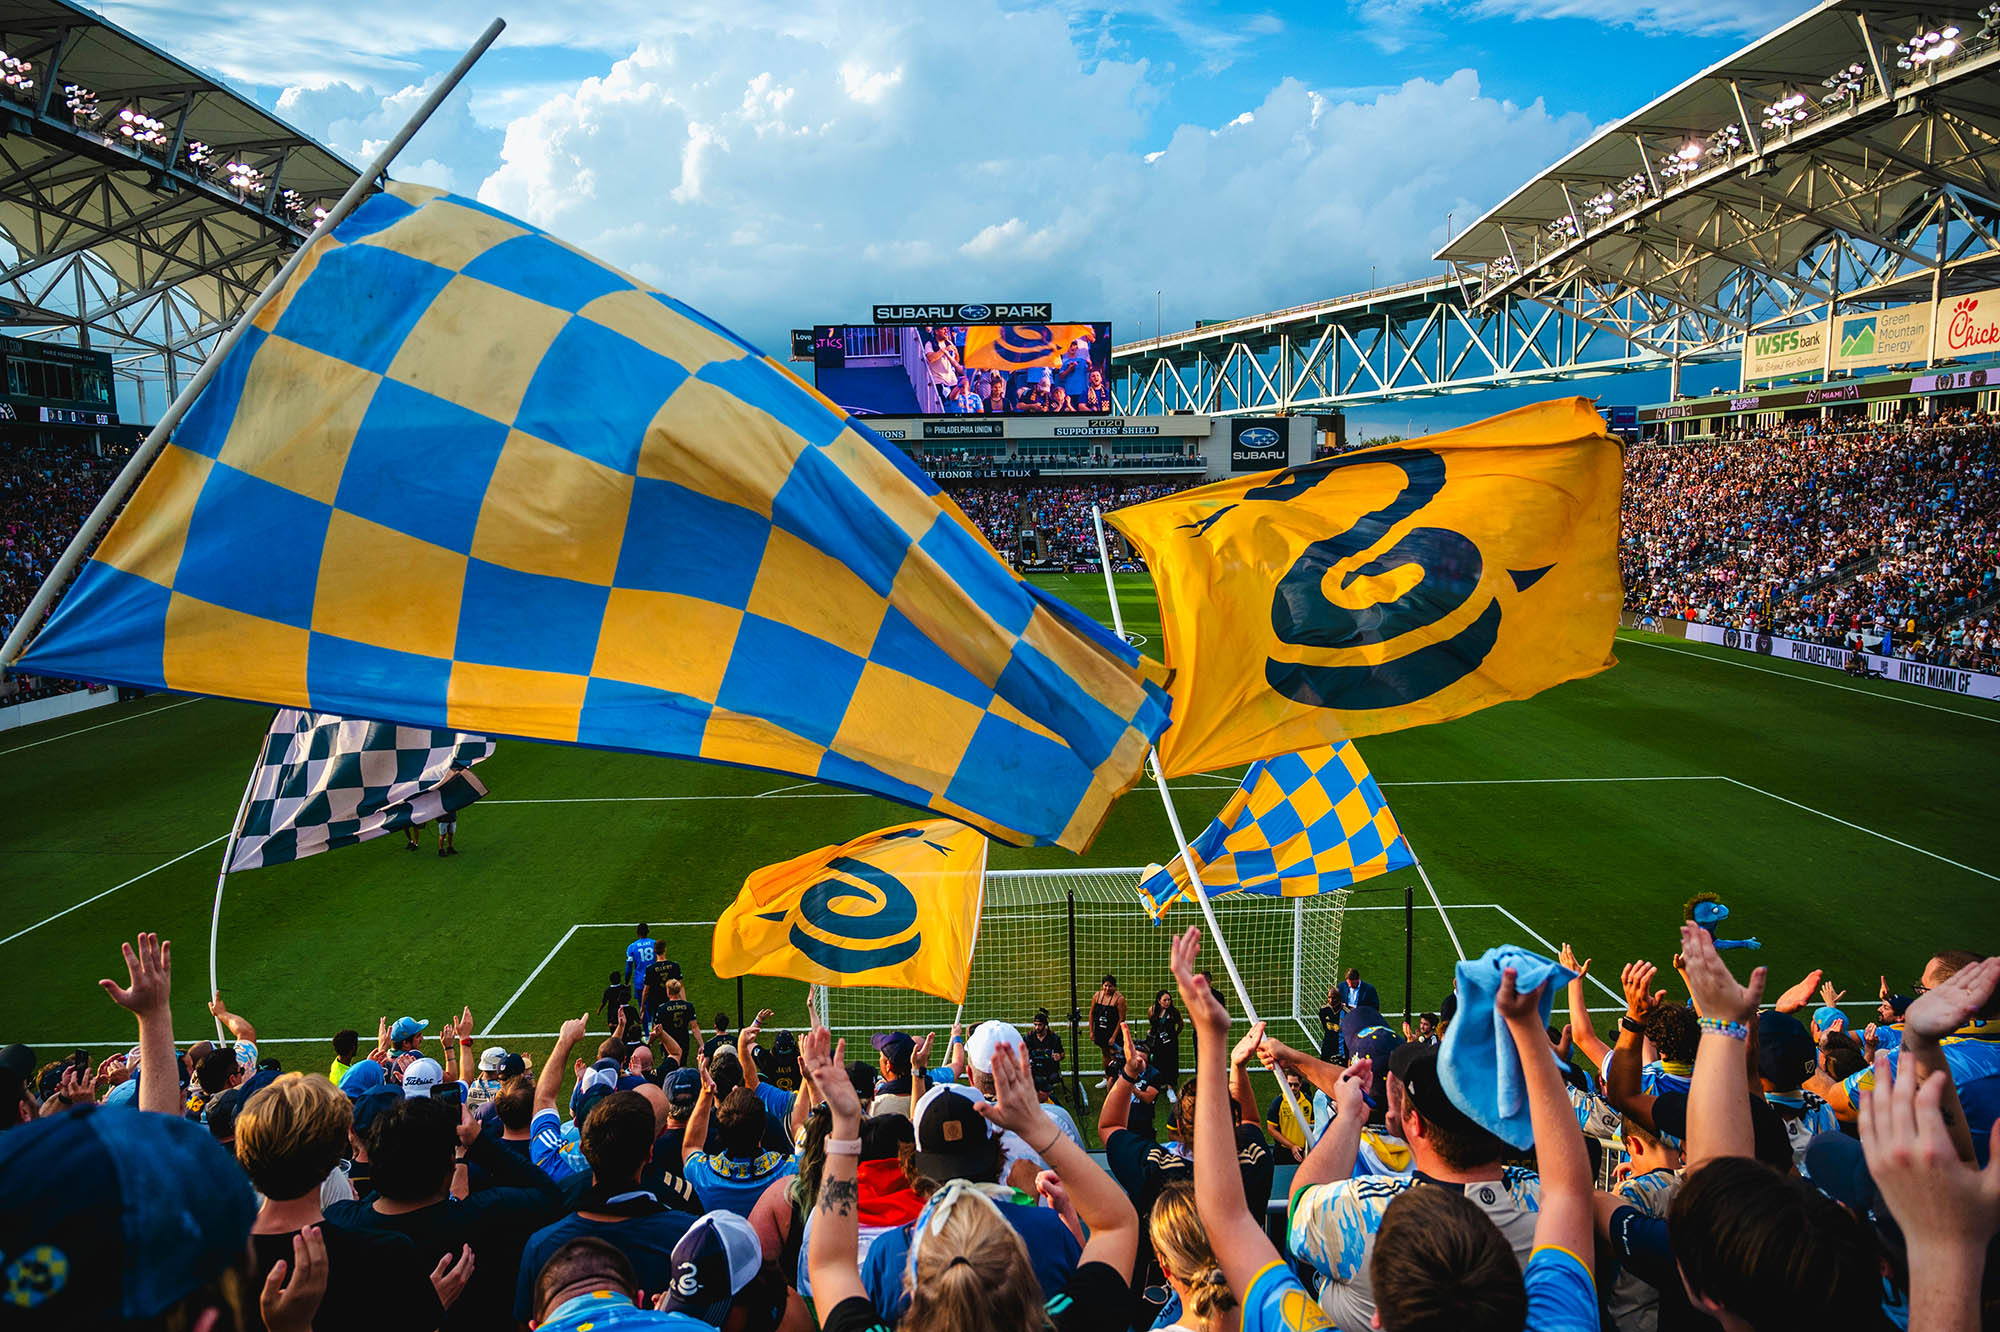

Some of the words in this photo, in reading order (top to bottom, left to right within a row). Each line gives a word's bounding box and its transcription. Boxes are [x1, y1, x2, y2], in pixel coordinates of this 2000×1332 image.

[876, 306, 954, 319] SUBARU
[995, 305, 1048, 318] PARK
[1880, 313, 1910, 327] Green
[795, 333, 812, 341] Love
[1879, 323, 1925, 340] Mountain
[1755, 330, 1799, 356] WSFS
[1800, 331, 1821, 348] bank
[1877, 340, 1912, 354] Energy
[1821, 390, 1843, 399] MIAMI
[934, 425, 974, 434] PHILADELPHIA
[974, 425, 993, 433] UNION
[1056, 427, 1120, 436] SUPPORTERS'
[1122, 426, 1157, 434] SHIELD
[1232, 451, 1285, 460] SUBARU
[938, 470, 972, 478] HONOR
[983, 470, 998, 478] LE
[1000, 469, 1031, 478] TOUX
[1791, 642, 1843, 668] PHILADELPHIA
[1900, 661, 1926, 685] INTER
[1927, 666, 1957, 691] MIAMI
[1957, 673, 1972, 693] CF
[637, 947, 654, 962] 18
[404, 1076, 434, 1087] Titleist
